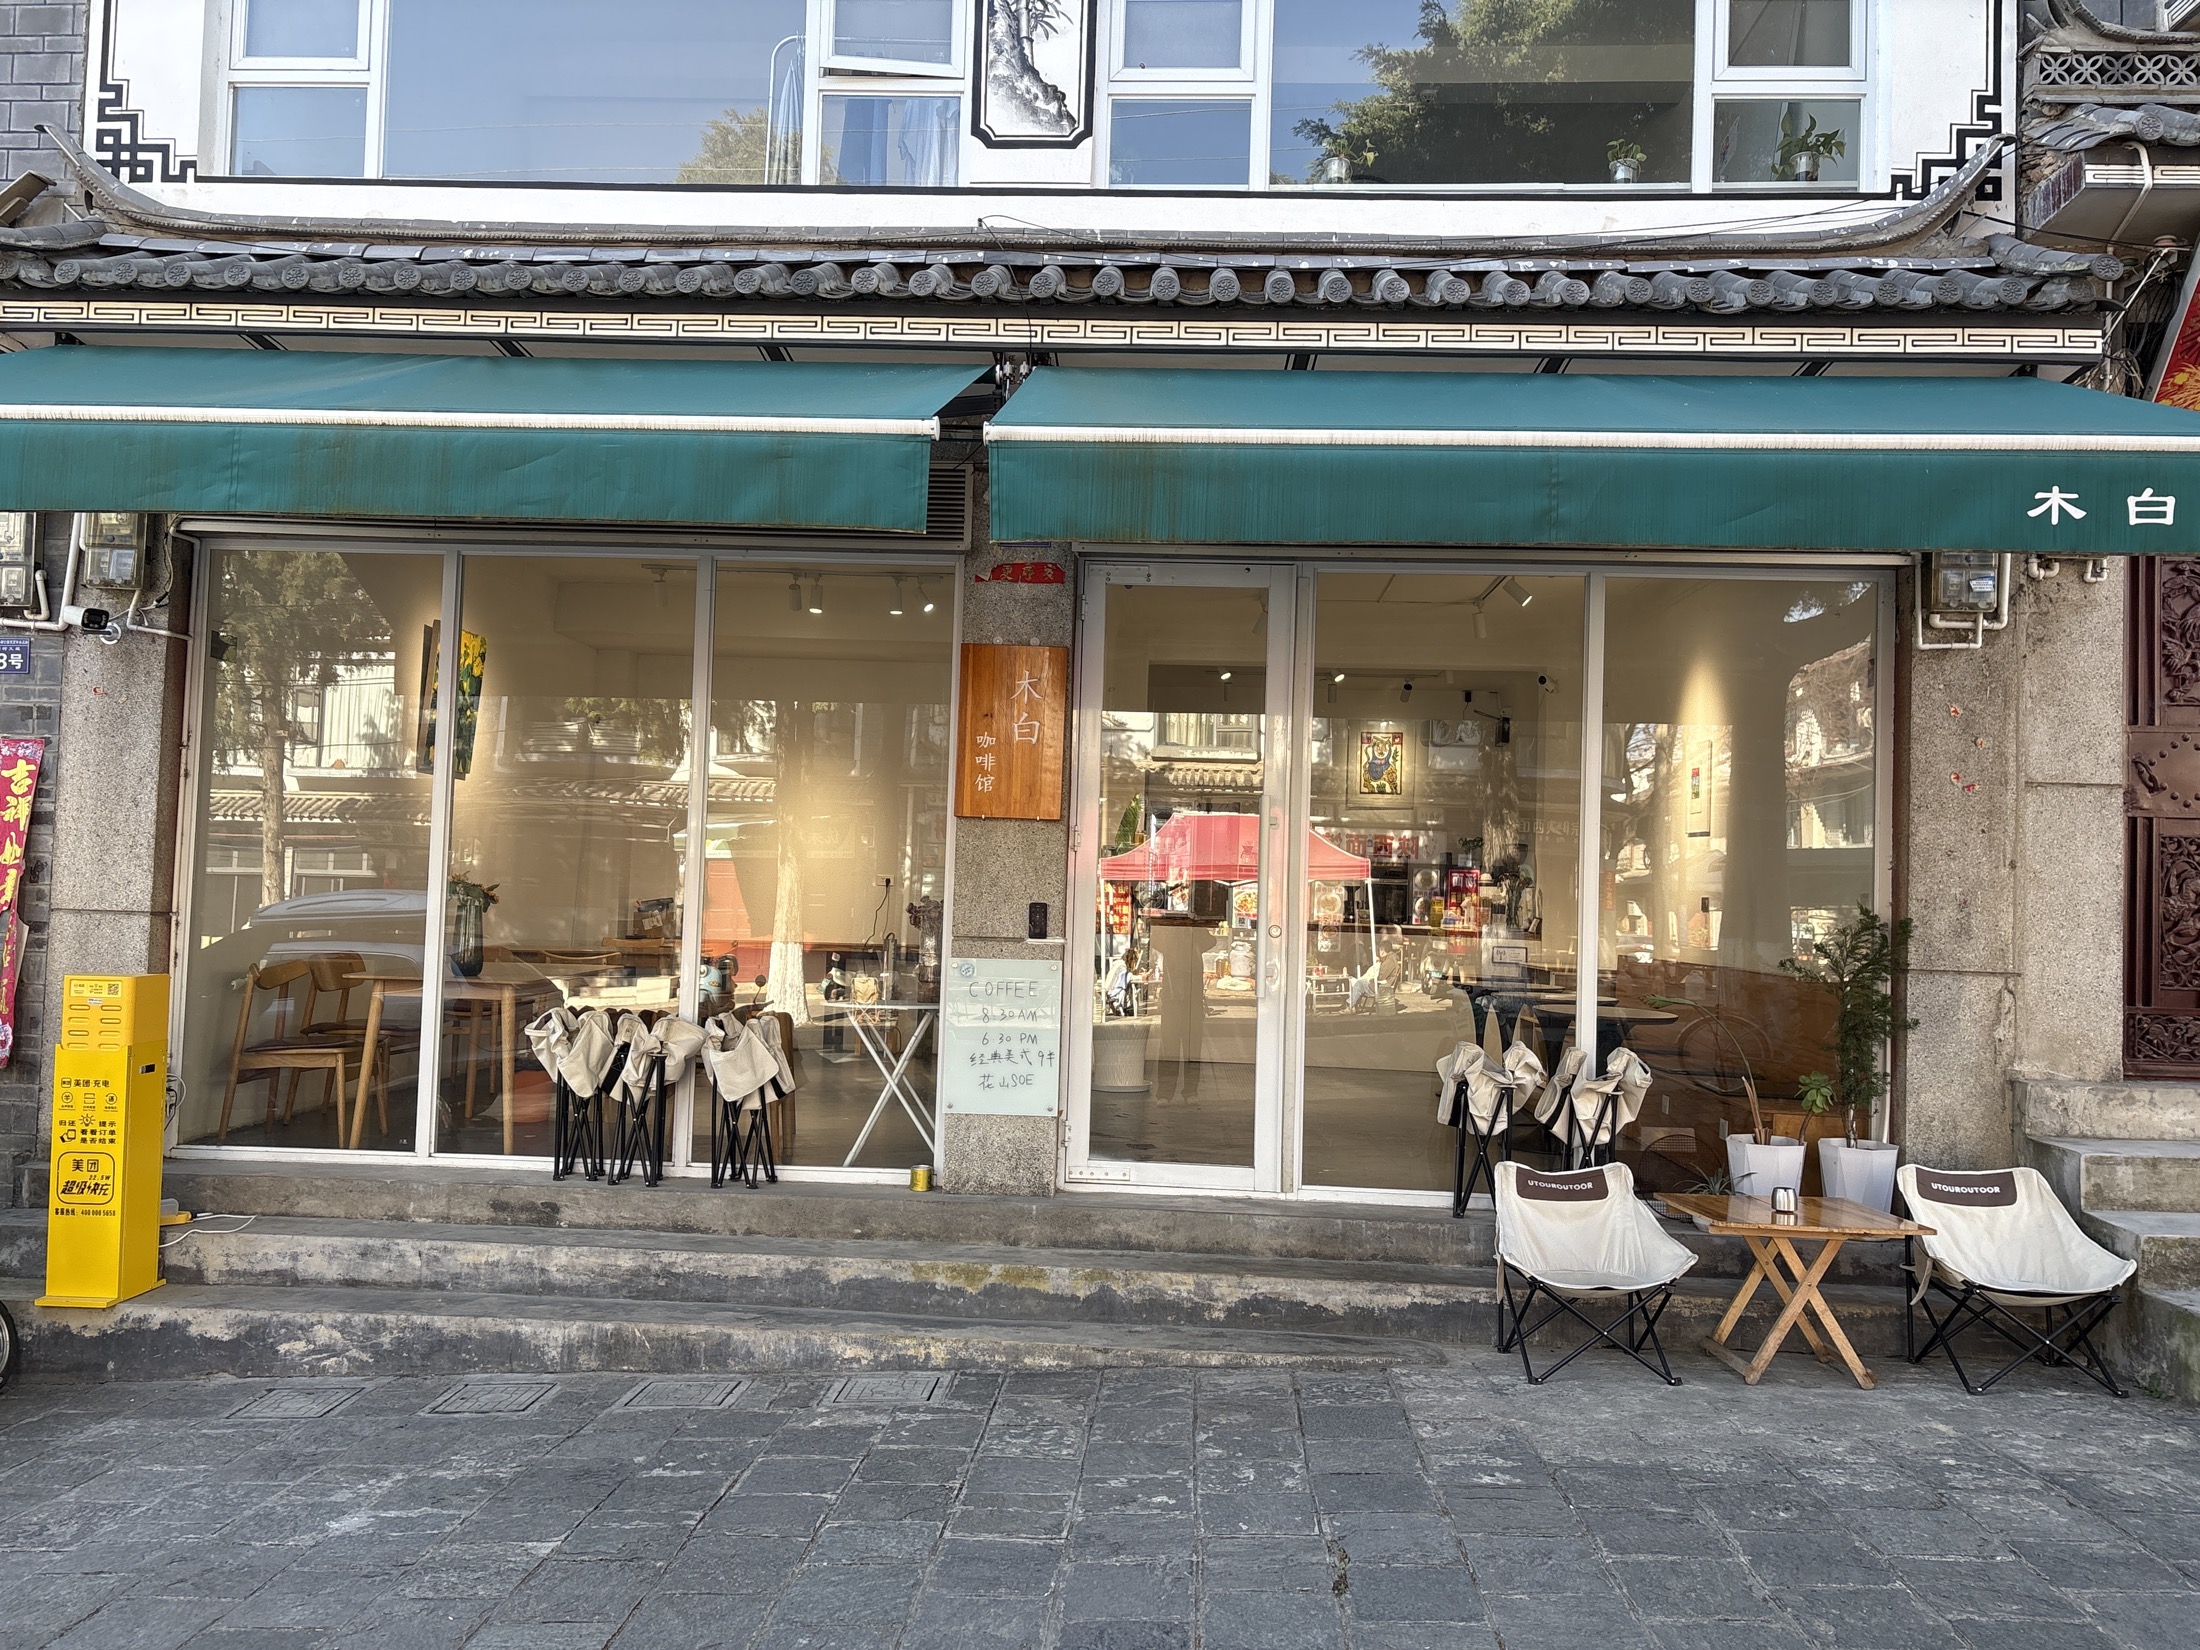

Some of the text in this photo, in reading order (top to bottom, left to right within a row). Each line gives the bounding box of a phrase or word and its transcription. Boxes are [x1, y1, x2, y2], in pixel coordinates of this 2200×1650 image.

[2026, 485, 2176, 526] 木白
[1010, 670, 1043, 745] 木白
[975, 731, 996, 793] 咖啡馆
[969, 981, 1039, 998] COFFEE
[1020, 1032, 1038, 1045] PM
[59, 1119, 117, 1128] 归还 提示
[80, 1128, 117, 1136] 看看订单
[71, 1158, 99, 1173] 美团
[60, 1180, 112, 1195] 超级快充
[1527, 1179, 1593, 1191] UTOUROUTOOR
[1931, 1182, 2001, 1194] UTOUROUTOOR
